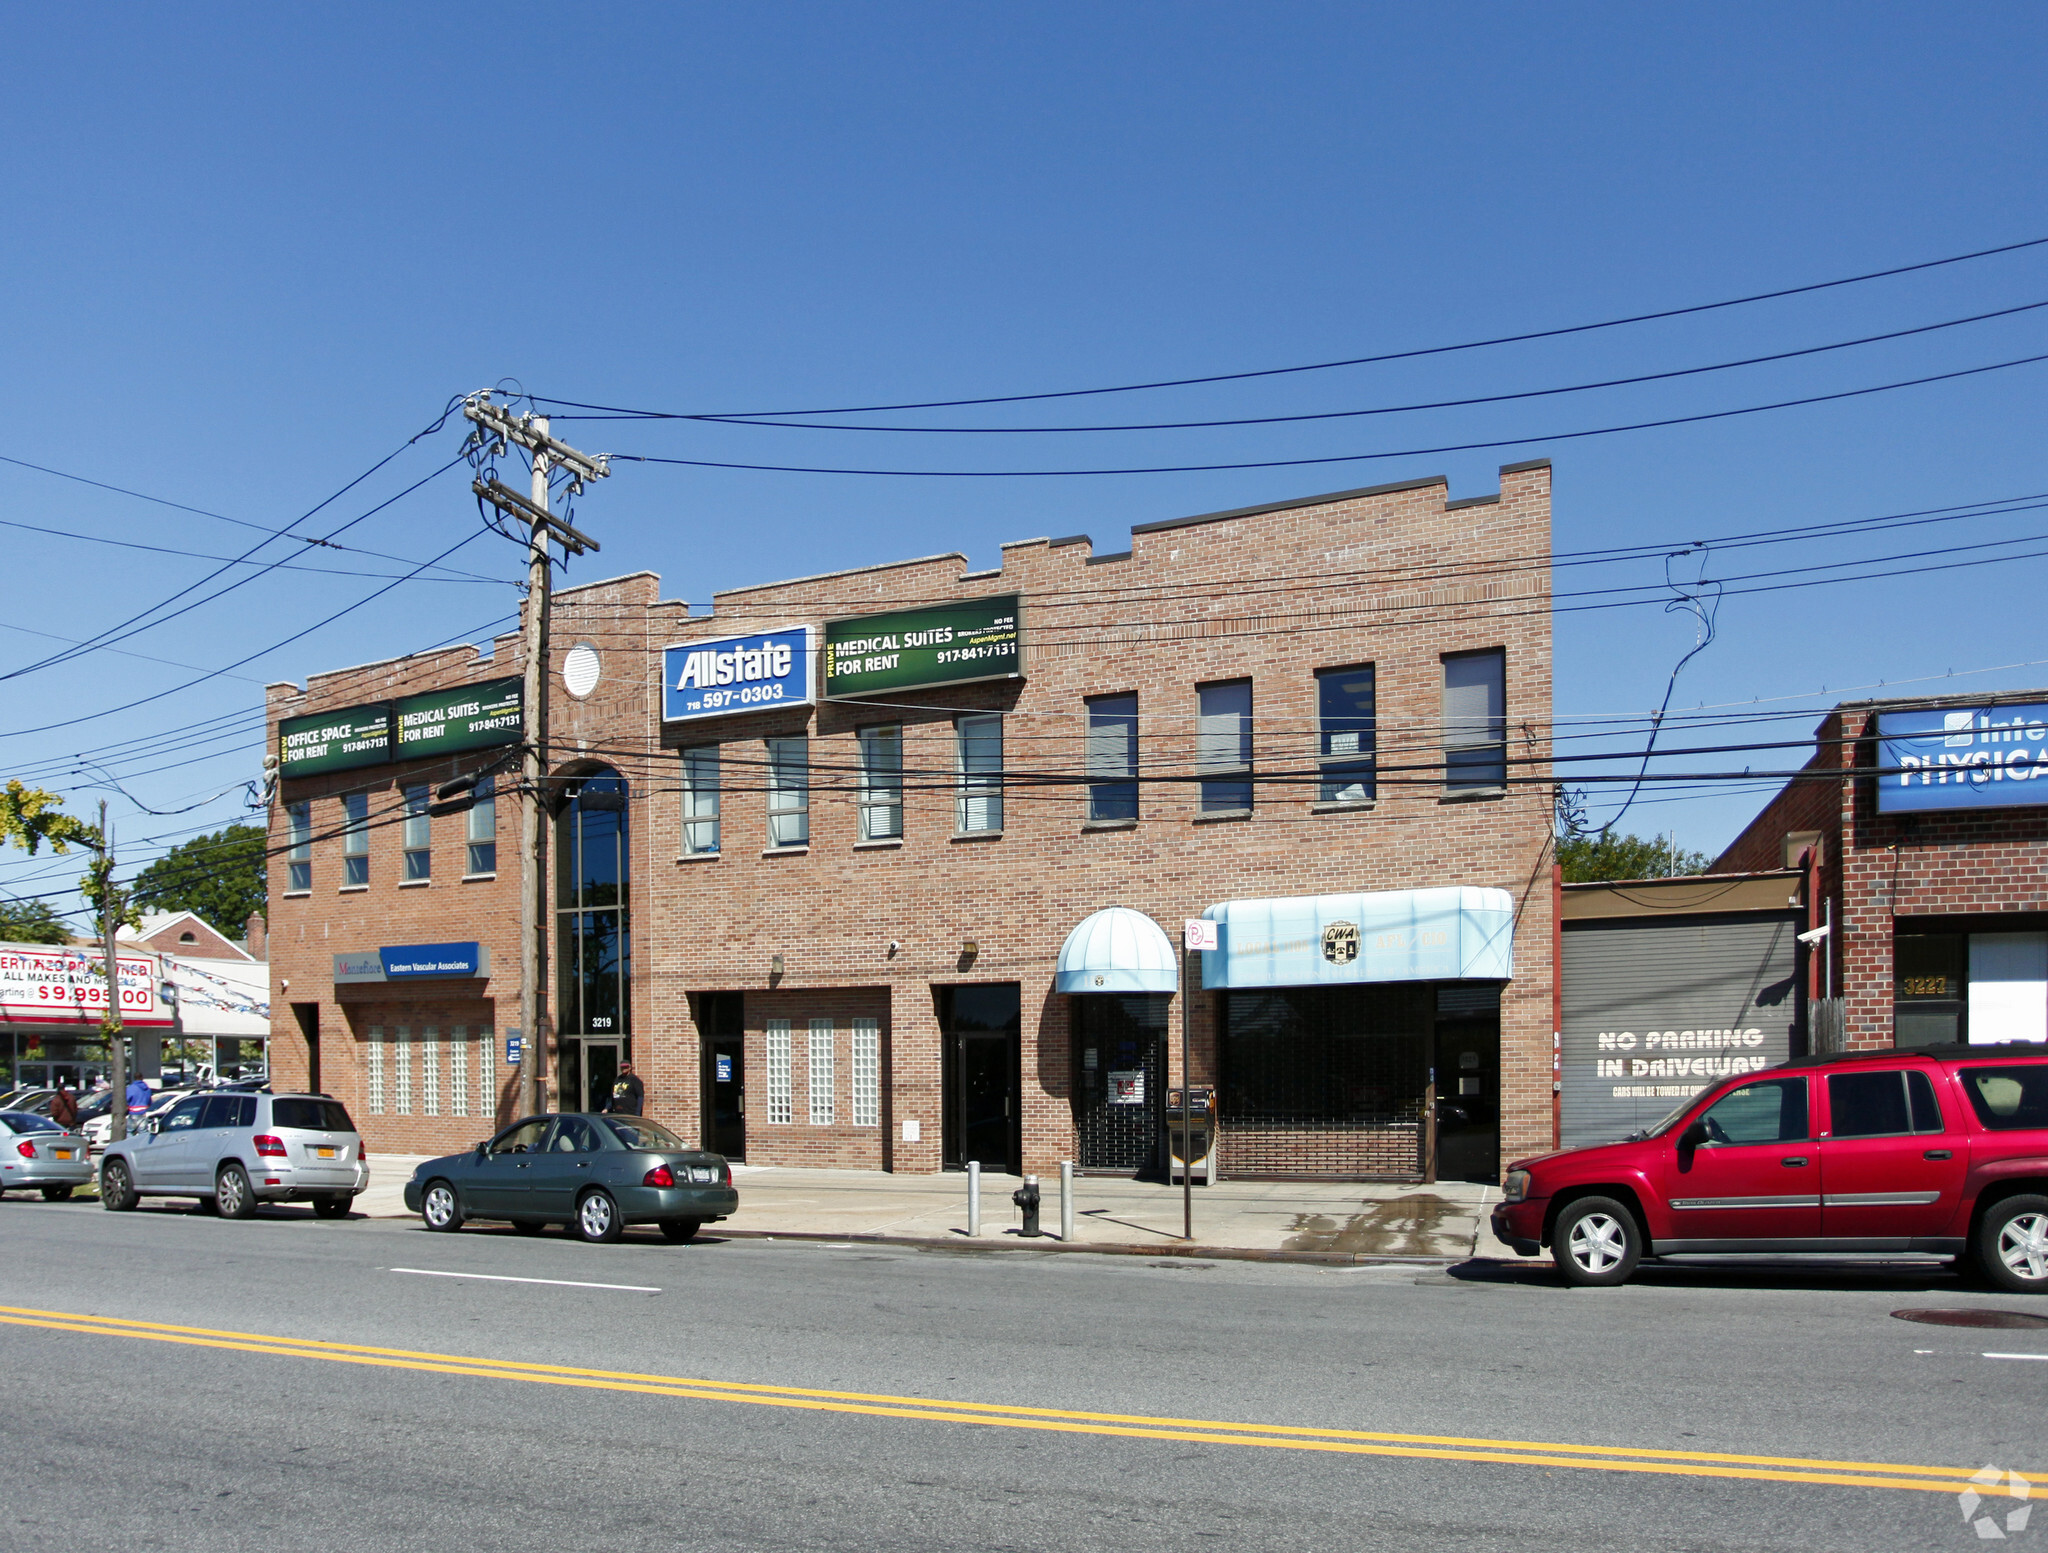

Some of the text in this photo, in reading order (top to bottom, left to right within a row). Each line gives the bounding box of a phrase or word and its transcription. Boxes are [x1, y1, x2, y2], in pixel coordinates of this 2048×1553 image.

[835, 626, 953, 657] MEDICAL SUITES
[676, 640, 792, 691] Allstate
[826, 642, 835, 678] PRIME
[836, 659, 862, 676] FOR
[865, 653, 900, 672] RENT
[686, 683, 784, 711] 718 597-0303
[404, 701, 480, 727] MEDICAL SUITES
[287, 729, 320, 748] OFFICE
[321, 724, 352, 742] SPACE
[404, 728, 421, 742] FOR
[422, 724, 446, 738] RENT
[287, 748, 305, 762] FOR
[305, 743, 329, 759] RENT
[1326, 927, 1354, 940] CWA
[1236, 940, 1281, 955] LOCAL
[389, 963, 412, 973] Eastern
[412, 962, 437, 972] Vascular
[437, 961, 469, 971] Associates
[4, 972, 23, 981] ALL
[27, 972, 65, 983] MAKES
[69, 974, 91, 984] AND
[1903, 976, 1947, 995] 3227
[592, 1017, 612, 1028] 3219
[1598, 1028, 1765, 1051] NO PARKING
[1597, 1056, 1766, 1078] IN DRIVEWAY
[1612, 1086, 1631, 1098] CARS
[1631, 1086, 1645, 1097] WILL
[1646, 1086, 1656, 1097] BE
[1656, 1086, 1680, 1097] TOWED
[1680, 1086, 1689, 1097] AT
